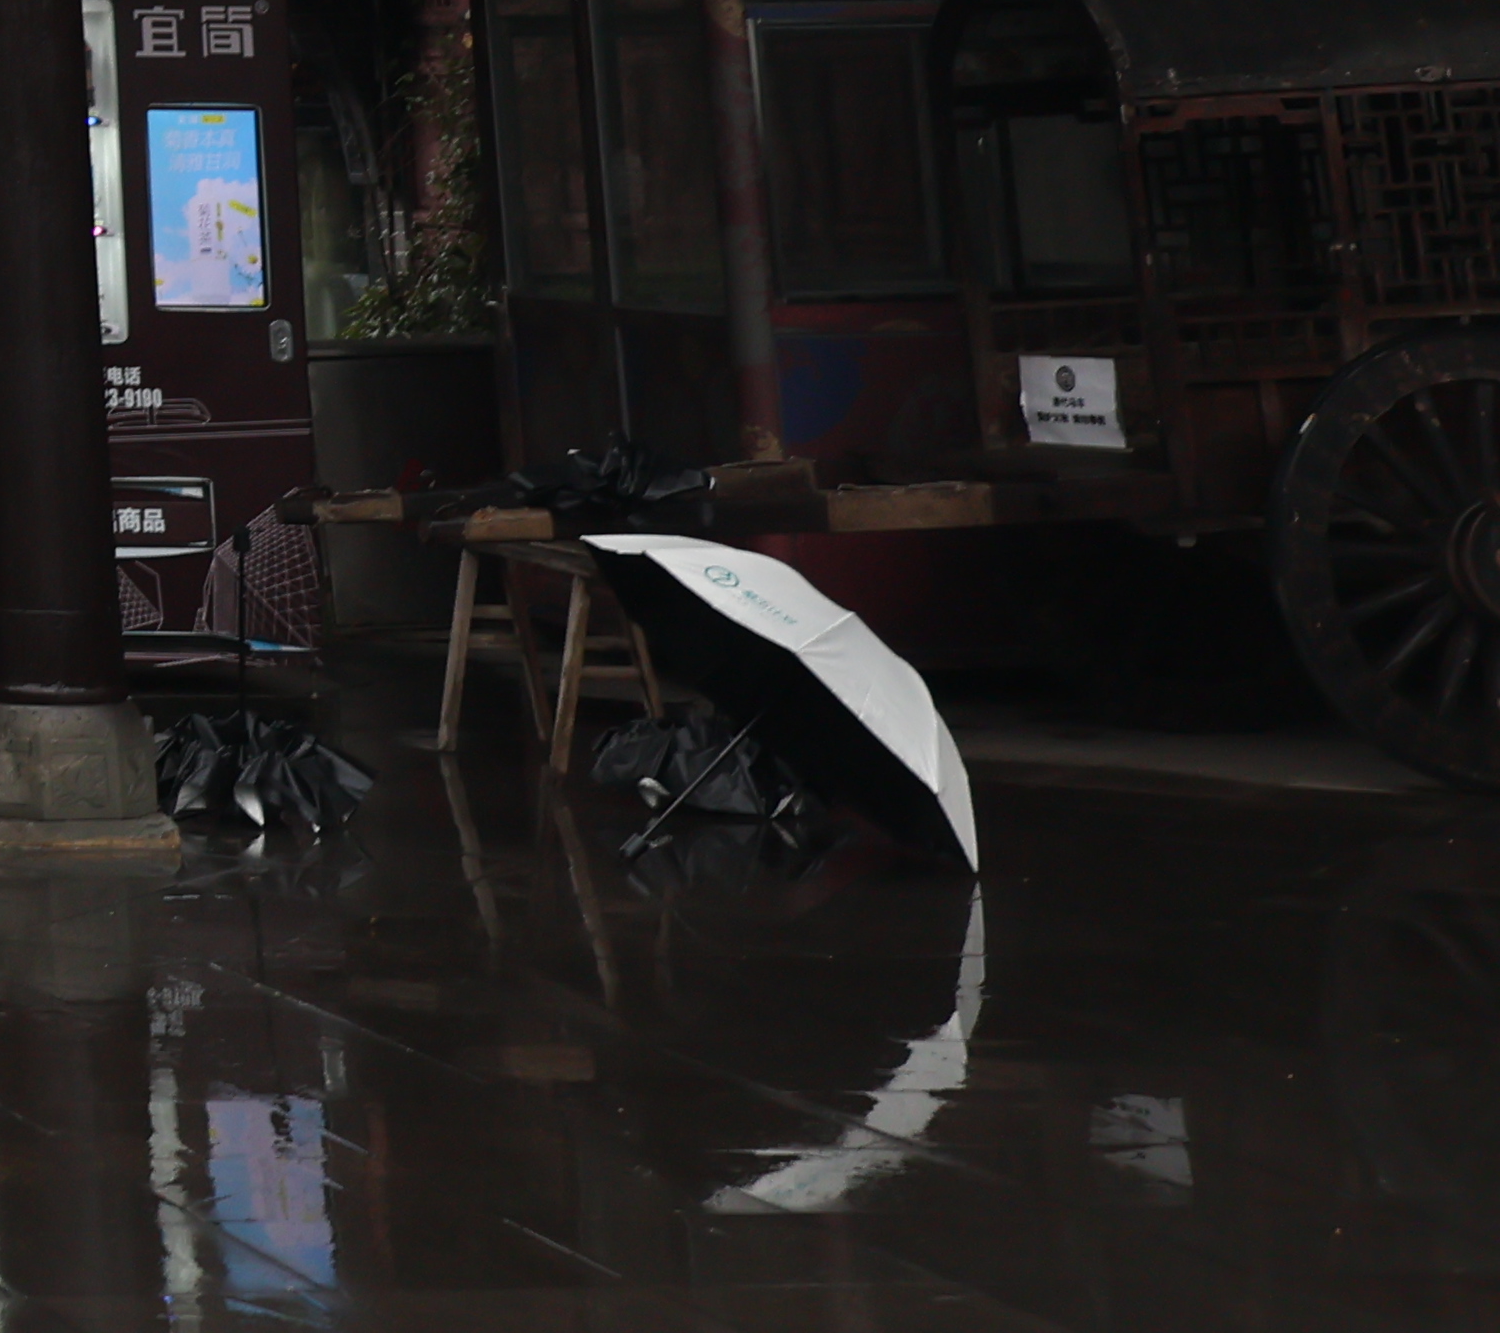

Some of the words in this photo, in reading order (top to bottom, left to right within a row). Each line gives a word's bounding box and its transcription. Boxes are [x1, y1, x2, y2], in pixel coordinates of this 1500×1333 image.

[132, 5, 255, 59] 宜简
[103, 365, 142, 386] 电话
[112, 506, 167, 535] 商品
